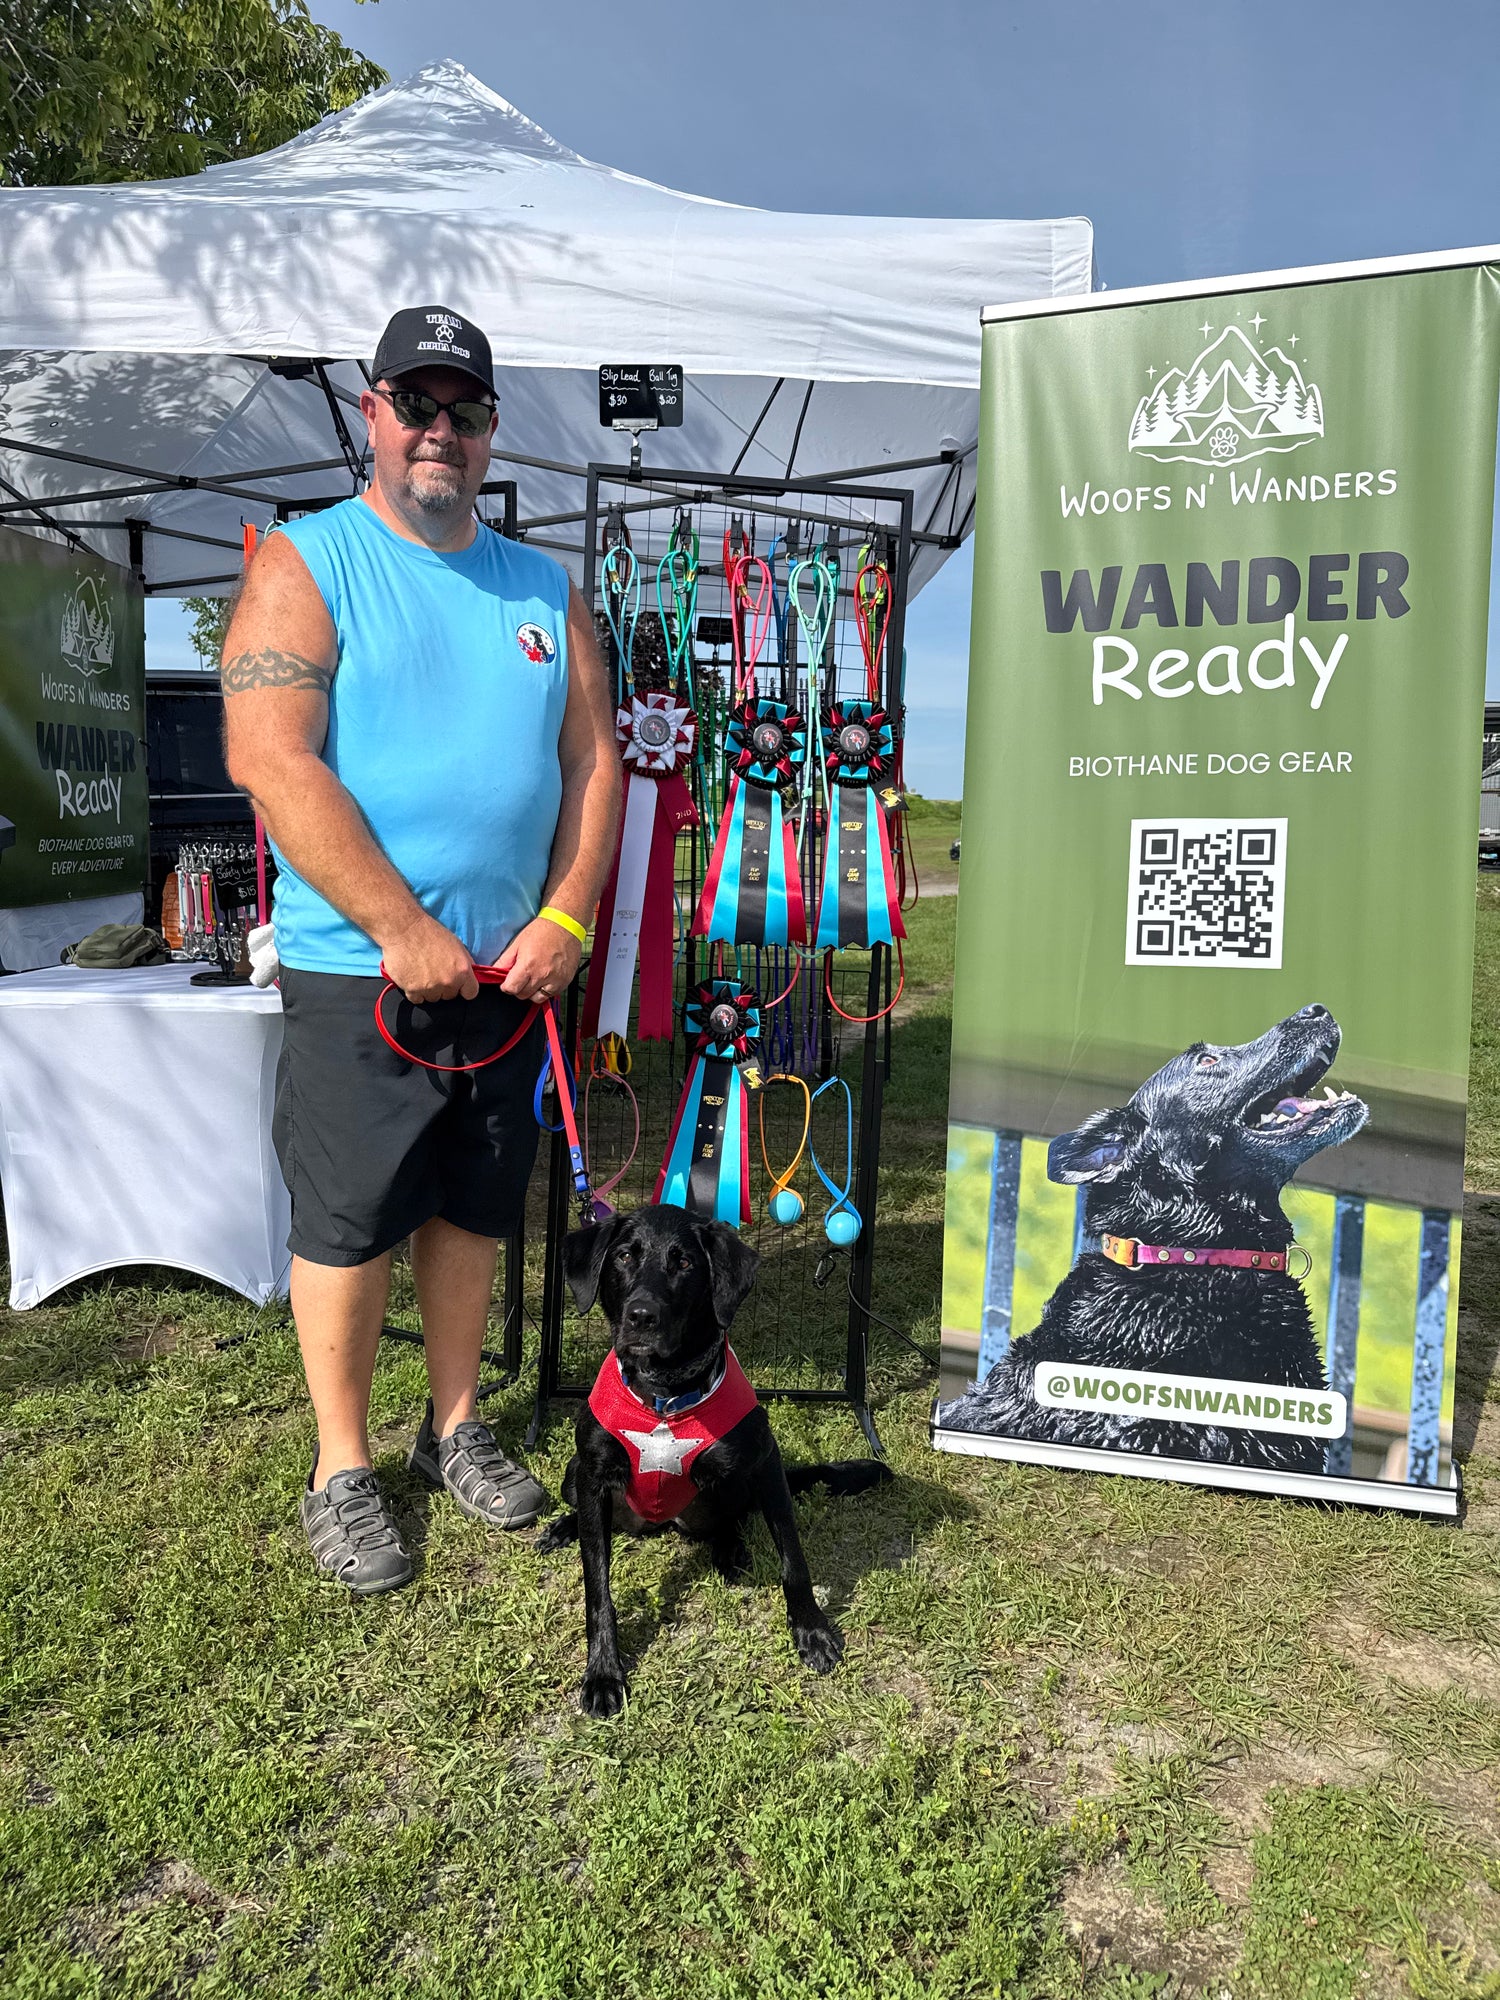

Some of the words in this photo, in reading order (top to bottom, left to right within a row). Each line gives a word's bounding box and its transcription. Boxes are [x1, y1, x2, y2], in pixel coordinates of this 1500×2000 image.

[425, 313, 463, 330] TEAM
[416, 341, 451, 352] ALPHA
[451, 344, 470, 359] DOG
[601, 368, 619, 385] Slip
[620, 368, 642, 383] Lead
[648, 368, 664, 382] Ball
[665, 367, 678, 388] Tug
[608, 393, 628, 408] $30
[658, 393, 677, 406] $20
[1060, 481, 1172, 518] WOOFS
[1185, 473, 1216, 509] N'
[1230, 467, 1398, 505] WANDERS
[1040, 551, 1411, 634] WANDER
[1092, 612, 1350, 710] Ready
[41, 672, 76, 704] WOOFS
[88, 682, 131, 712] WANDERS
[36, 721, 137, 774] WANDER
[1069, 753, 1199, 777] BIOTHANE
[1206, 752, 1271, 775] DOG
[1278, 751, 1353, 774] GEAR
[55, 762, 122, 825] Ready
[675, 808, 692, 820] 2ND
[38, 838, 85, 853] BIOTHANE
[85, 837, 104, 851] DOG
[105, 835, 122, 850] GEAR
[122, 834, 135, 848] FOR
[51, 860, 78, 876] EVERY
[78, 857, 125, 874] ADVENTURE
[216, 866, 241, 880] Safety
[237, 885, 257, 899] $15
[1046, 1375, 1334, 1426] @WOOFSNWANDERS
